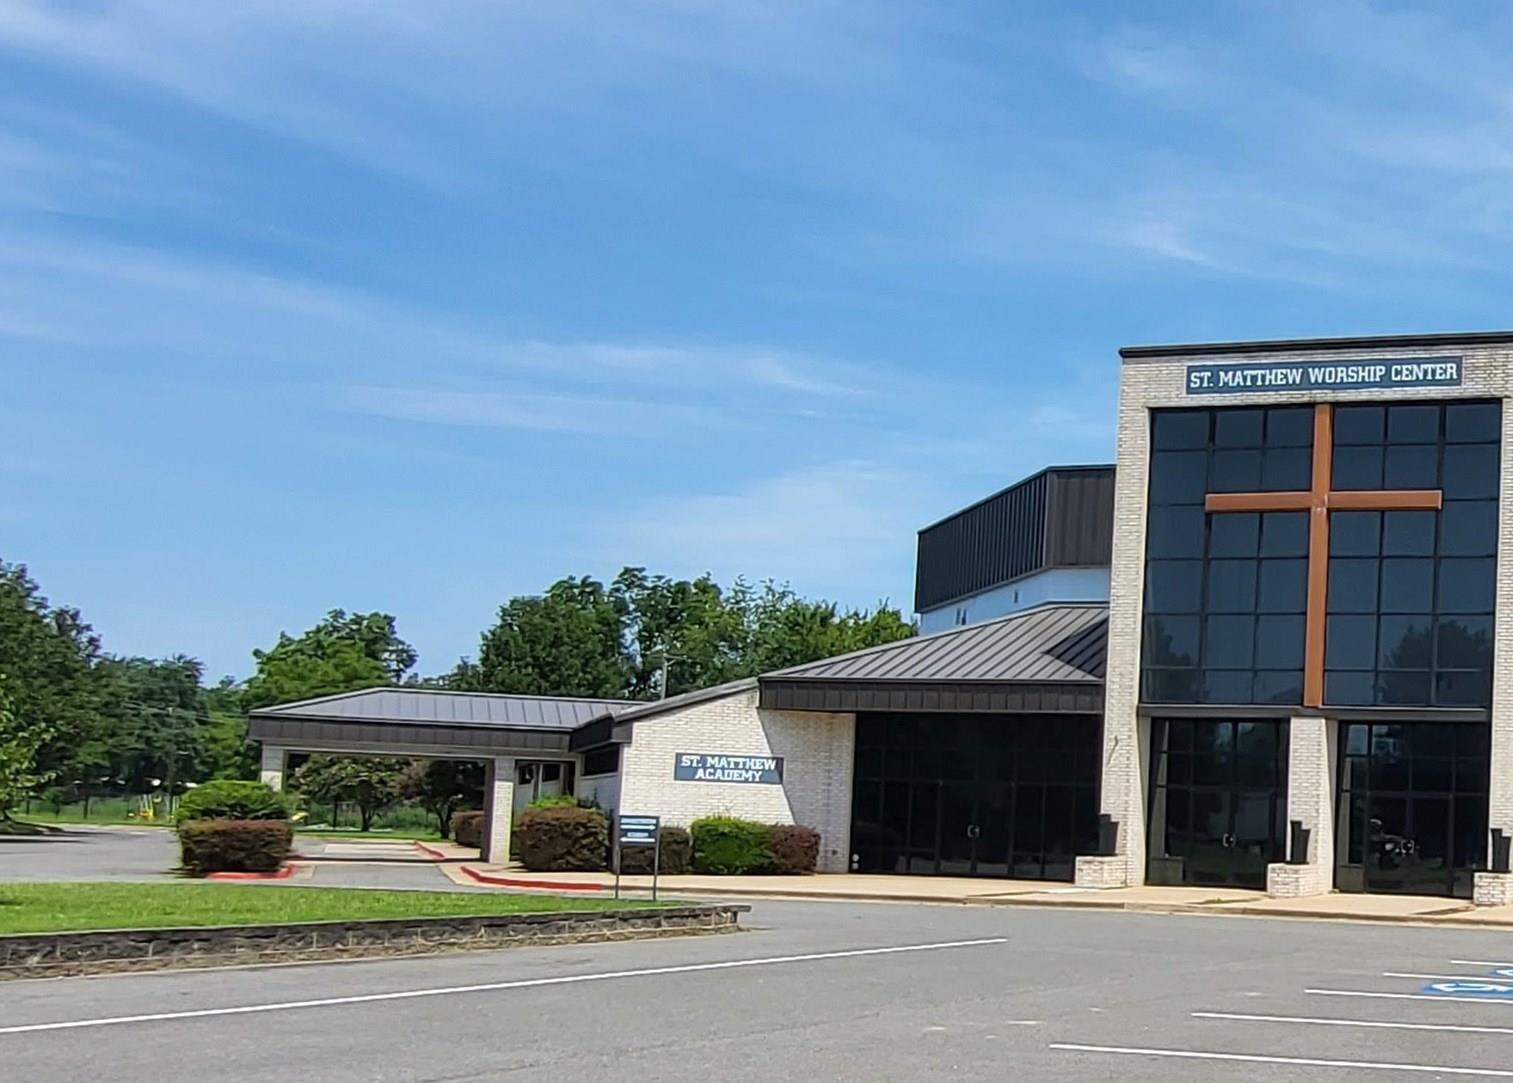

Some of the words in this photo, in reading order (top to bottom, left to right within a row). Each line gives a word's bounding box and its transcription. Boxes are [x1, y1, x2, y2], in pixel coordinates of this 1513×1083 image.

[1190, 371, 1214, 387] ST.
[1219, 367, 1302, 386] MATTHEW
[1308, 365, 1386, 383] WORSHIP
[1391, 363, 1458, 380] CENTER
[681, 755, 702, 767] ST.
[706, 757, 776, 770] MATTHEW
[695, 768, 762, 782] ACADEMY
